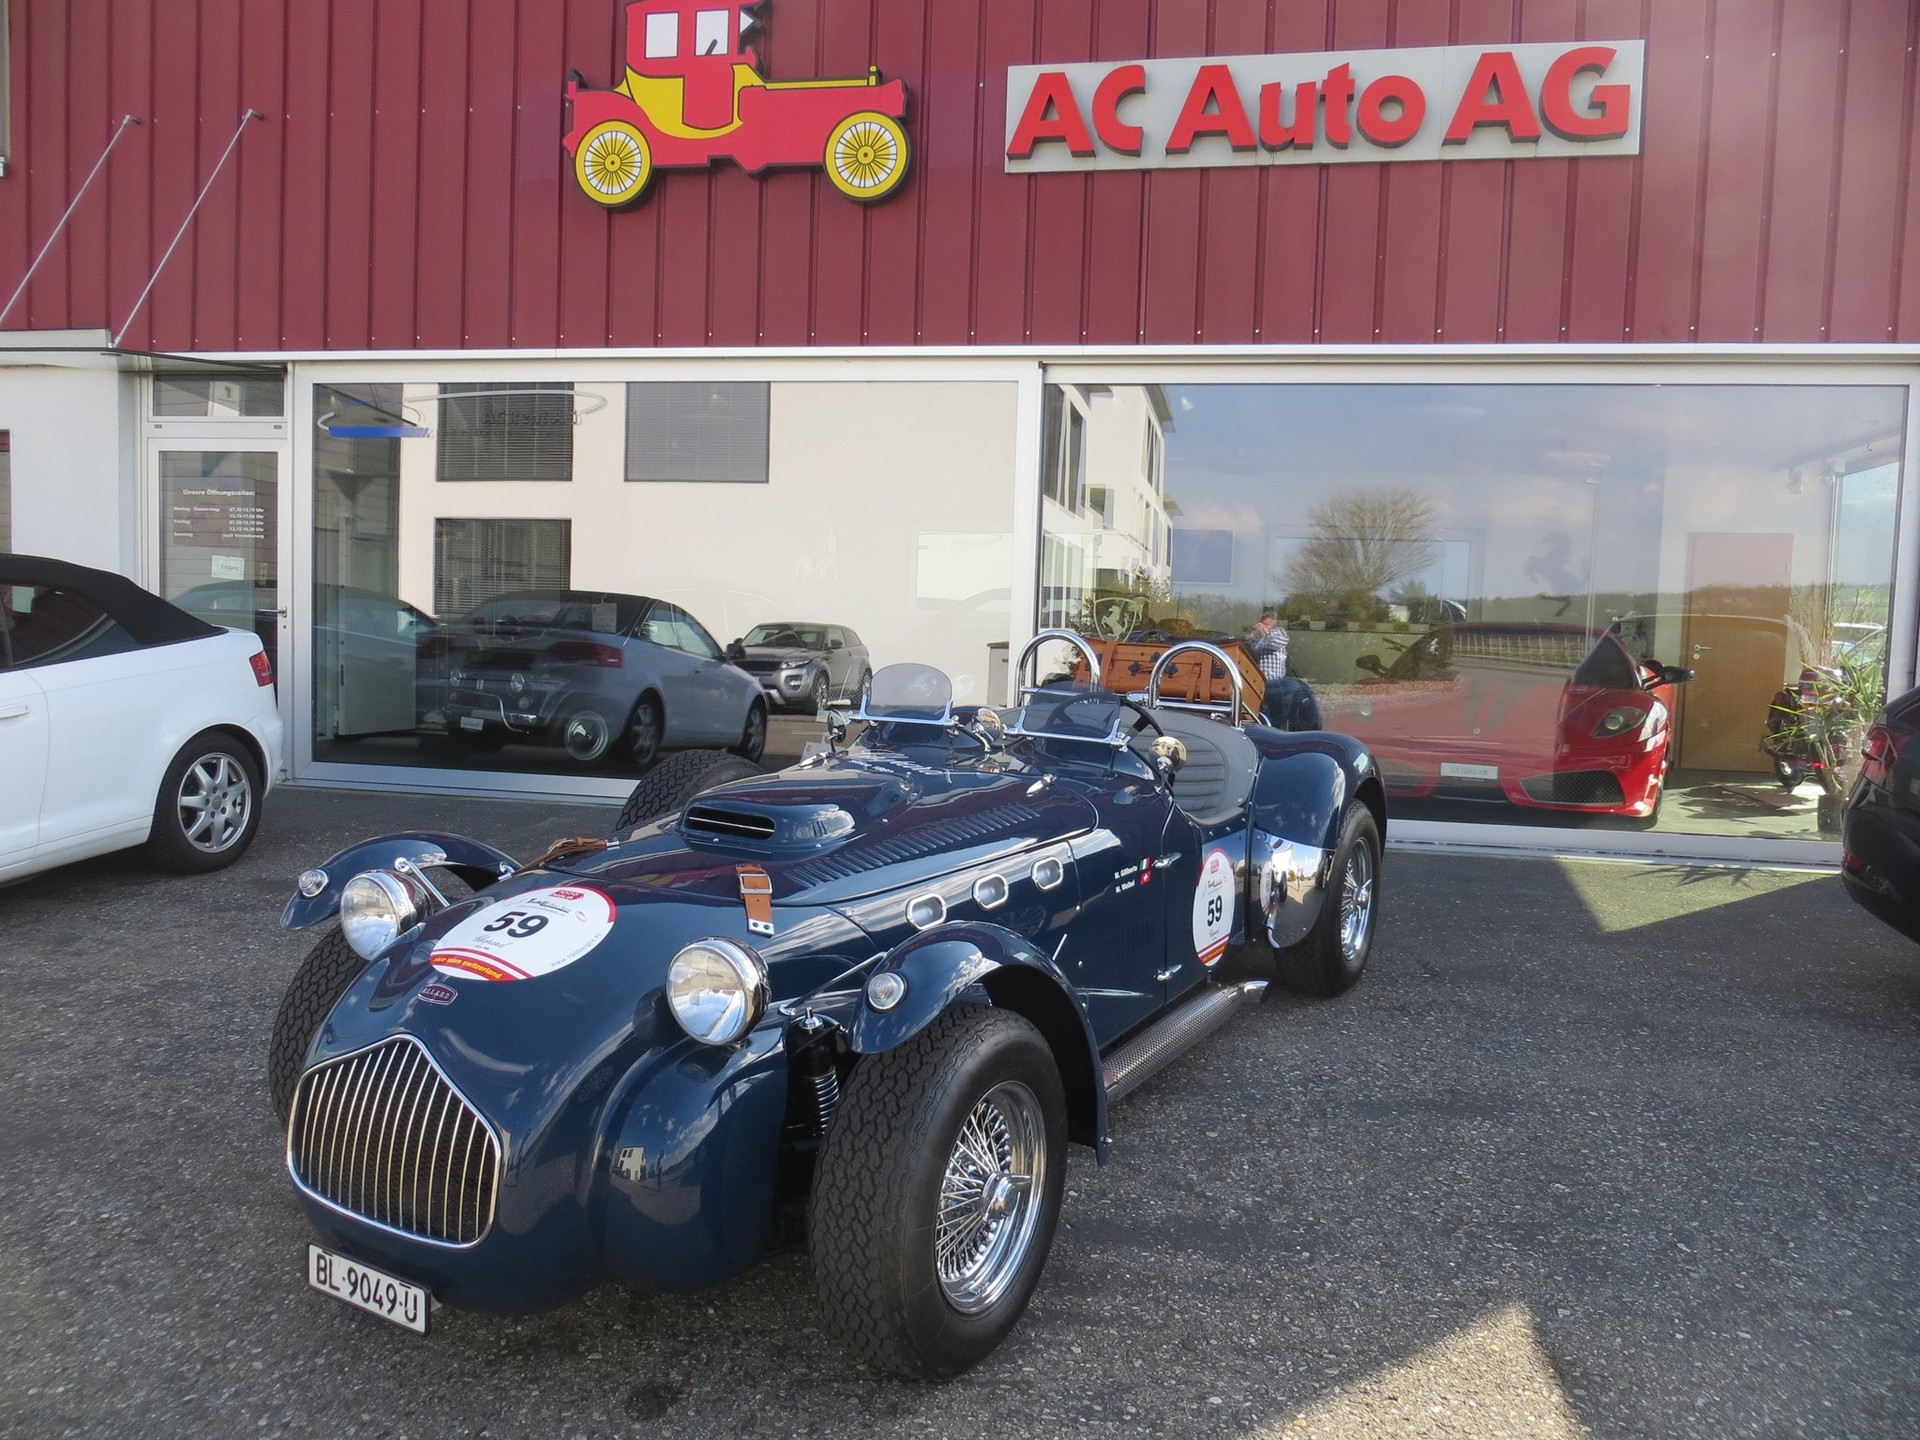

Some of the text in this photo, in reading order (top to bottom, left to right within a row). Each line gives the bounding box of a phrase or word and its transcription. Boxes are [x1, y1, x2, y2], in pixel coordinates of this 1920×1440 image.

[1006, 46, 1631, 160] AC Auto AG
[183, 488, 255, 497] Unsere Öffnungszeiten:
[1207, 895, 1223, 927] 59
[483, 911, 549, 938] 59
[461, 960, 503, 980] switzerland
[421, 987, 450, 1000] ALLARD
